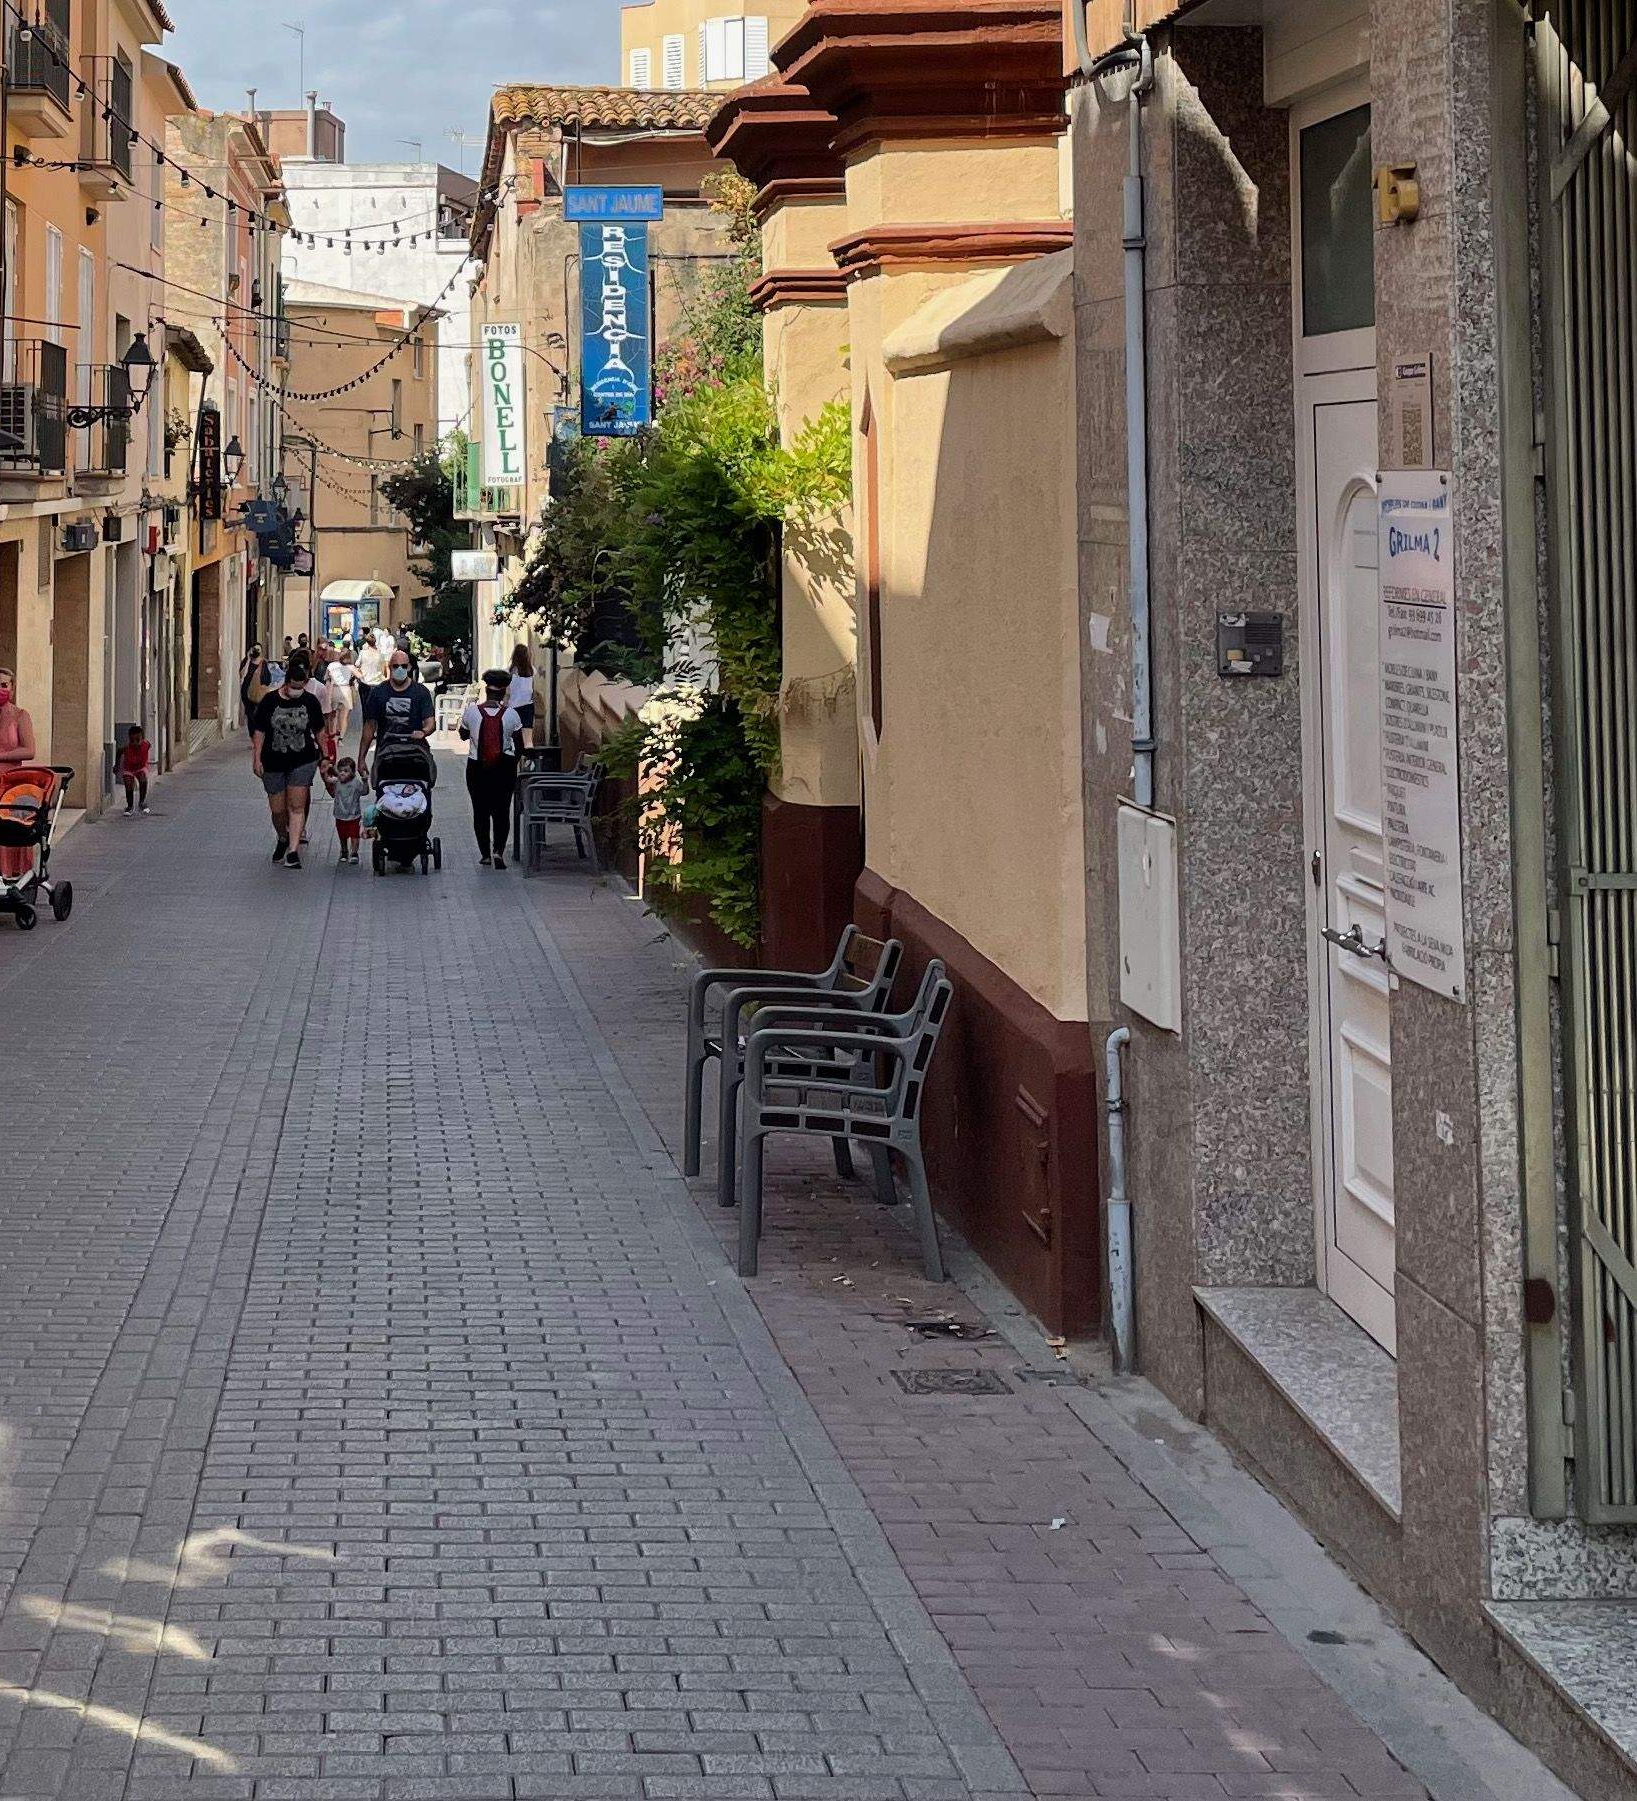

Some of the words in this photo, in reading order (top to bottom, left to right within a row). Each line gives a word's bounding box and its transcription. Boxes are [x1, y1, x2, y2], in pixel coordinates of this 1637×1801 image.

[569, 193, 608, 213] SANT
[611, 193, 659, 213] JAUME
[1373, 161, 1419, 226] 15
[484, 325, 517, 335] FOTOS
[488, 338, 520, 475] BONELL
[1390, 526, 1430, 557] GRILMA
[1434, 527, 1439, 561] 2
